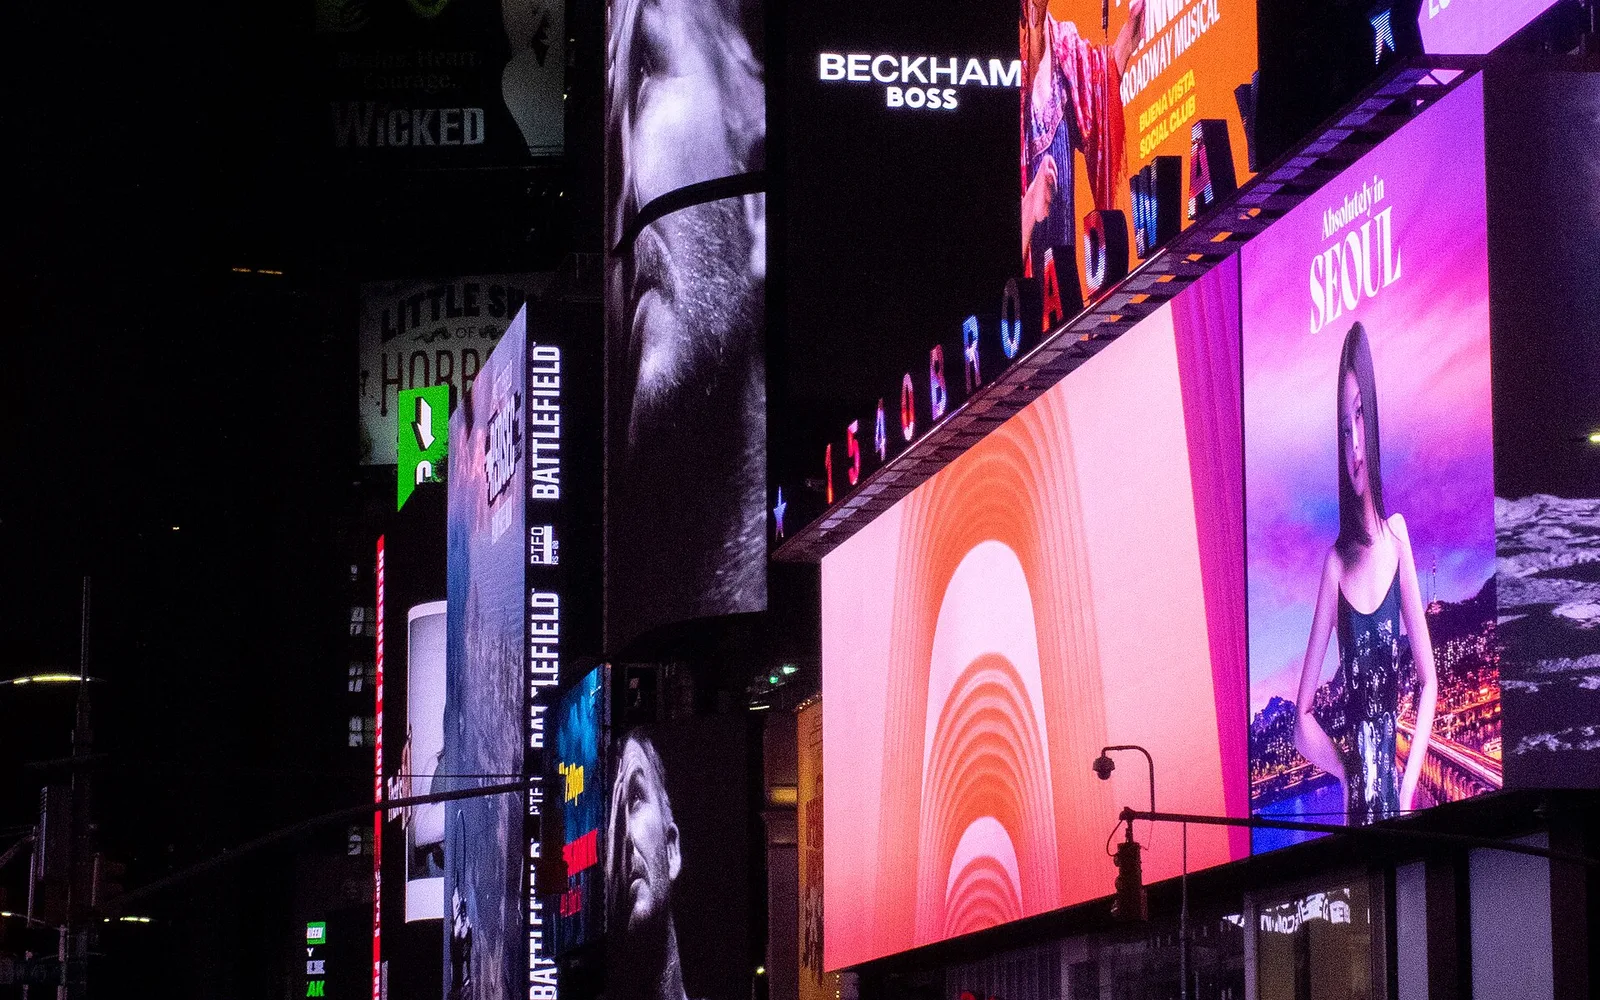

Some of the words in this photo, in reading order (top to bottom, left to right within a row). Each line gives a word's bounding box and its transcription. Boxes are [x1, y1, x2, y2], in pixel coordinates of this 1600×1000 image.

[819, 53, 1021, 88] BECKHAM
[1120, 28, 1173, 107] ROADWAY
[1174, 0, 1221, 59] MUSICAL
[886, 86, 958, 110] BOSS
[1138, 92, 1168, 133] BUENA
[1168, 69, 1196, 108] VISTA
[1138, 119, 1170, 159] SOCIAL
[1169, 93, 1197, 133] CLUB
[1321, 180, 1373, 242] Absolutely
[1372, 174, 1385, 204] in
[1309, 205, 1402, 335] SEOUL
[380, 282, 481, 343] LITTLE
[455, 327, 477, 339] OF
[380, 348, 494, 422] HORR
[531, 344, 561, 500] BATTLEFIELD
[824, 372, 915, 504] 1540
[531, 526, 544, 564] PTFO
[531, 593, 560, 748] LEFIELD
